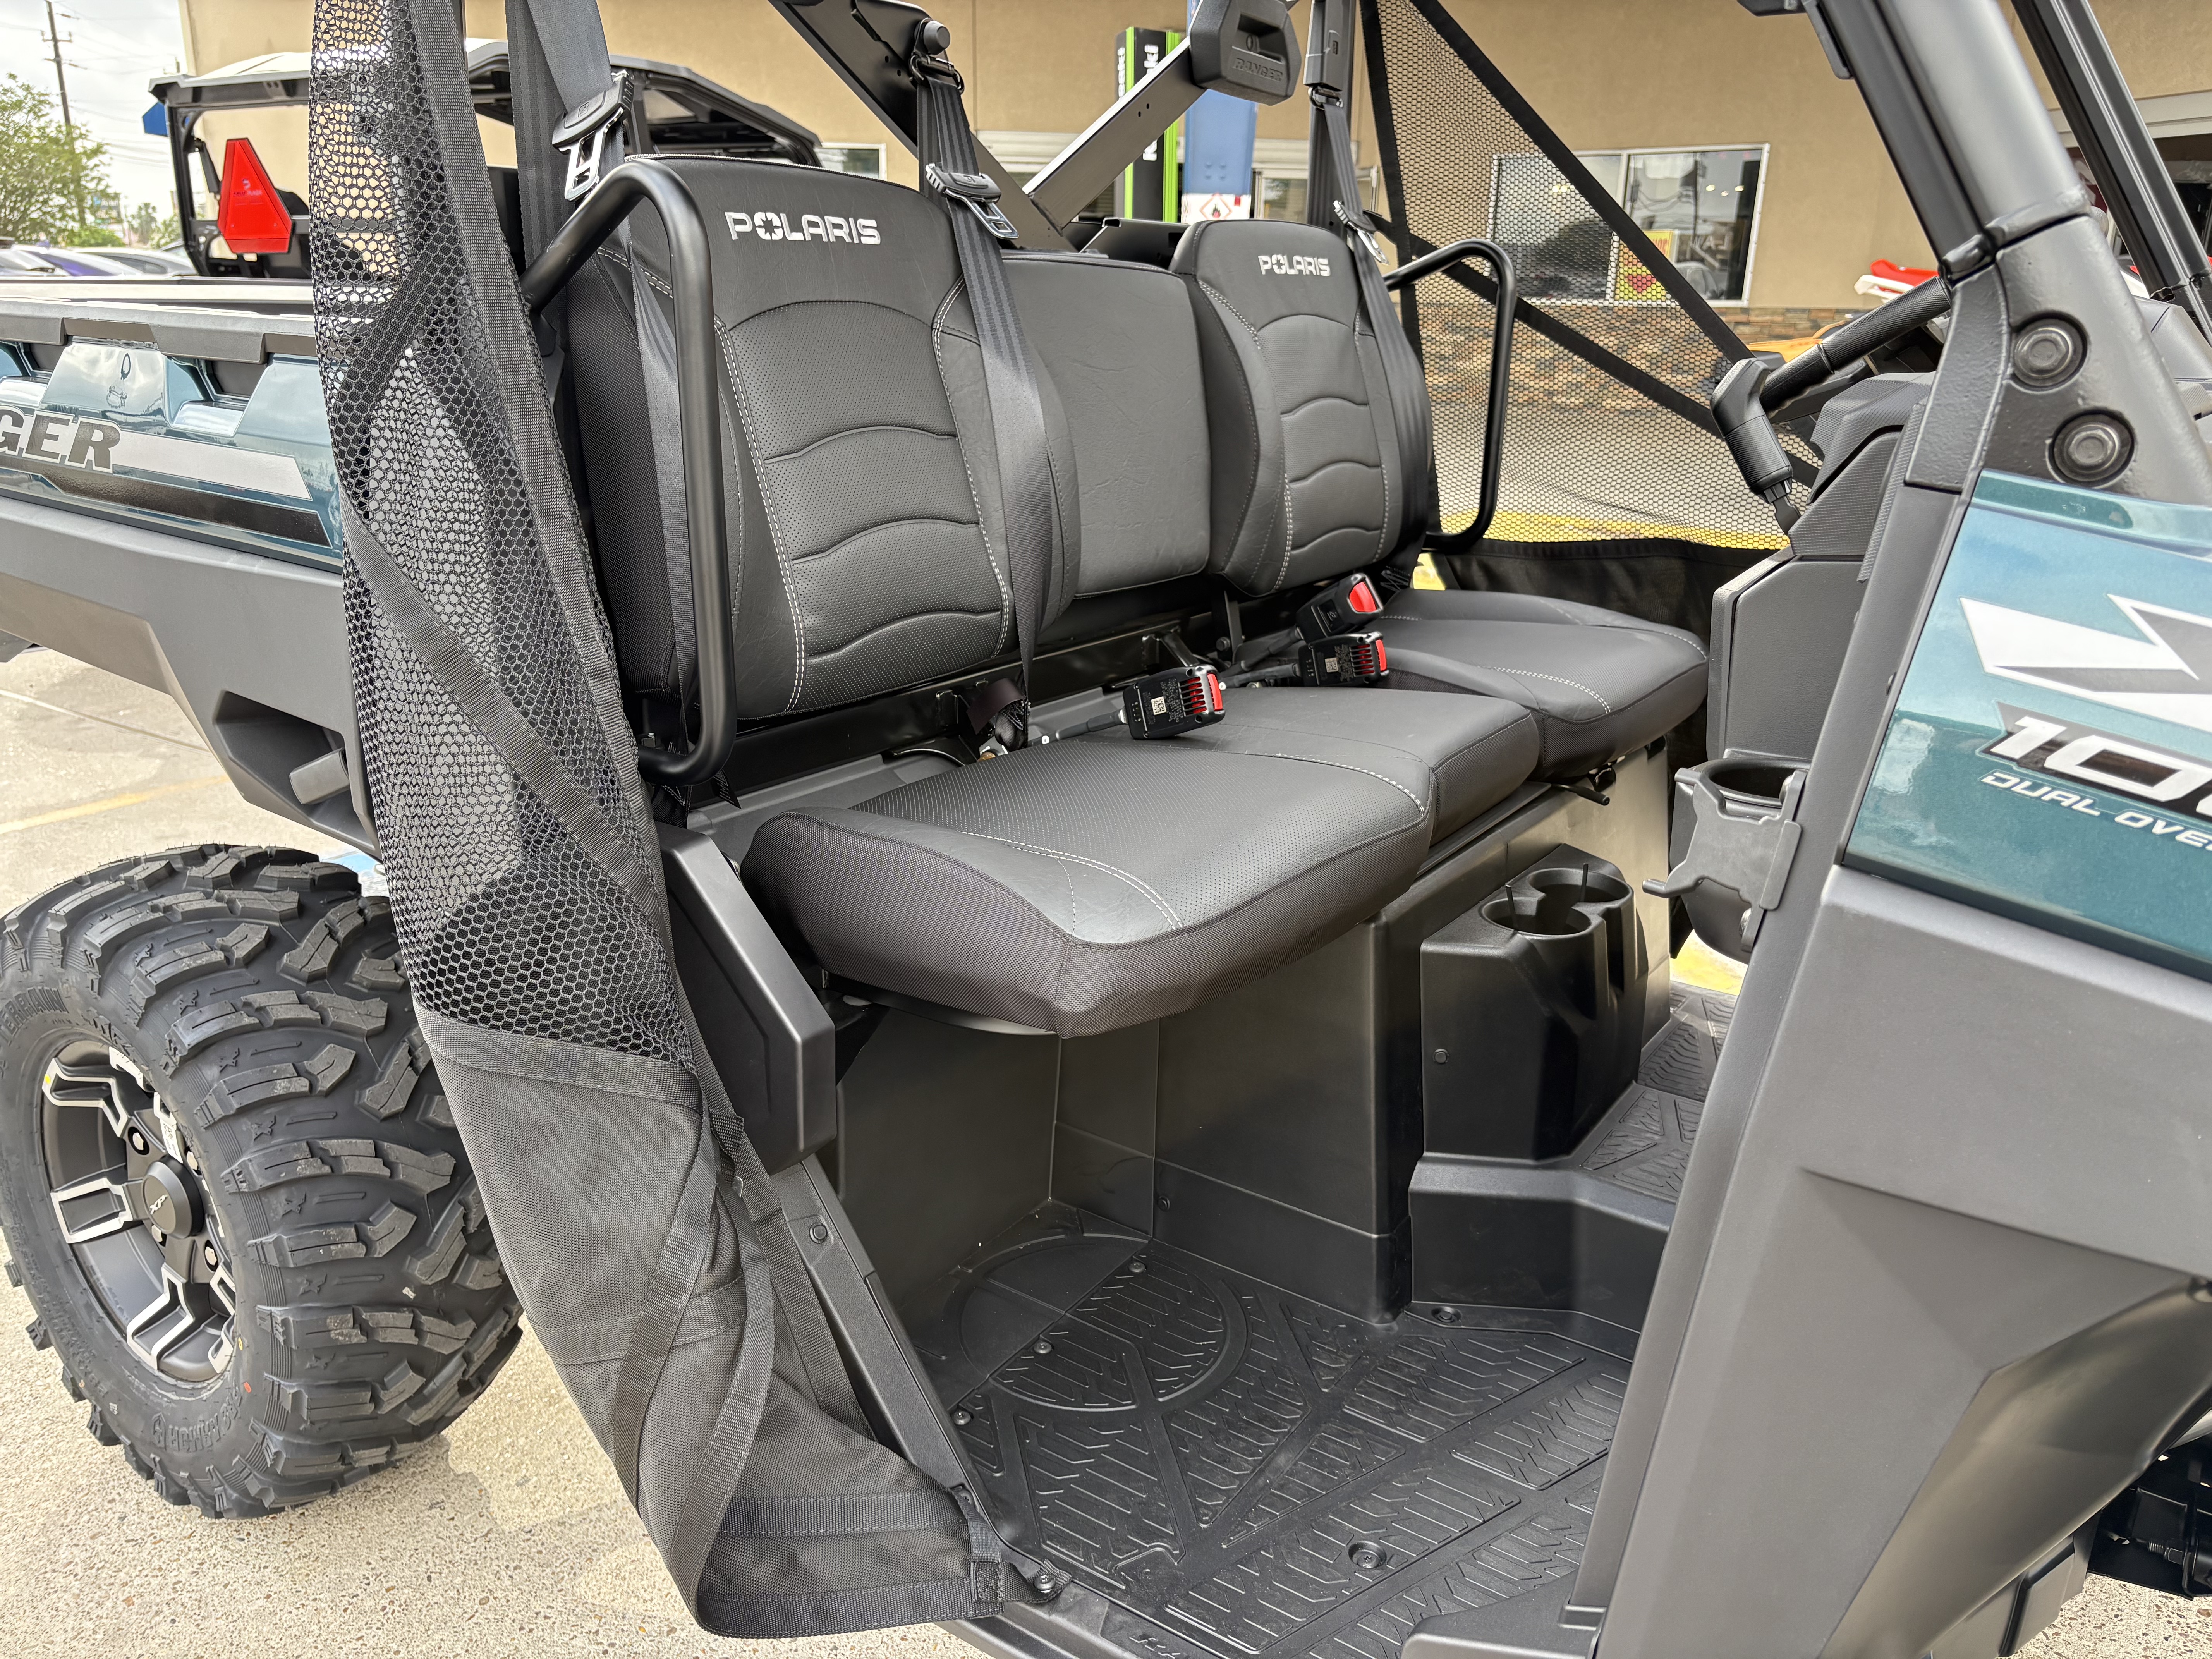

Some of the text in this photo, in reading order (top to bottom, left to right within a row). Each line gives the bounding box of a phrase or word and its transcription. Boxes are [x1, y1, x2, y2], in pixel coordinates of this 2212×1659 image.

[1233, 58, 1283, 81] RANGER
[725, 211, 881, 245] POLARIS
[1258, 254, 1331, 276] POLARIS
[1990, 716, 2212, 818] 10
[1980, 772, 2101, 816] DUAL
[149, 1195, 167, 1215] XP
